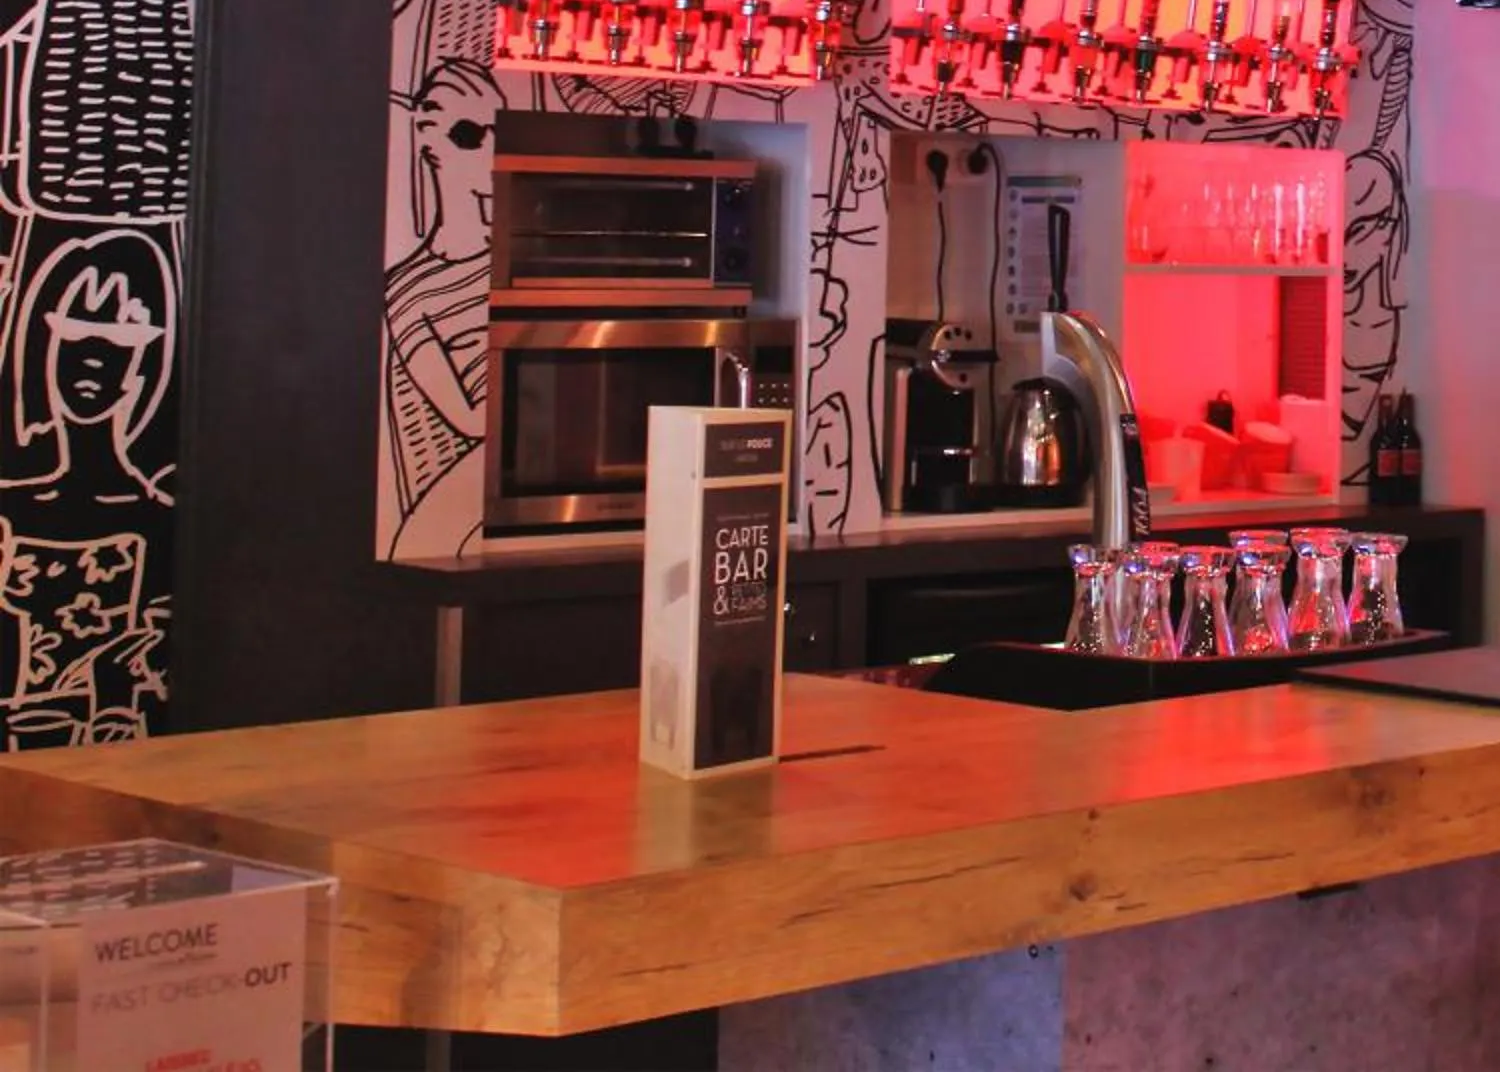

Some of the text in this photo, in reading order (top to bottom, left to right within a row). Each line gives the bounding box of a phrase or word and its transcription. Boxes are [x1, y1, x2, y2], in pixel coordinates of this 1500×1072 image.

[715, 525, 769, 550] CARTE
[714, 547, 769, 585] BAR
[713, 584, 730, 616] &
[94, 923, 219, 963] WELCOME
[90, 984, 150, 1016] FAST
